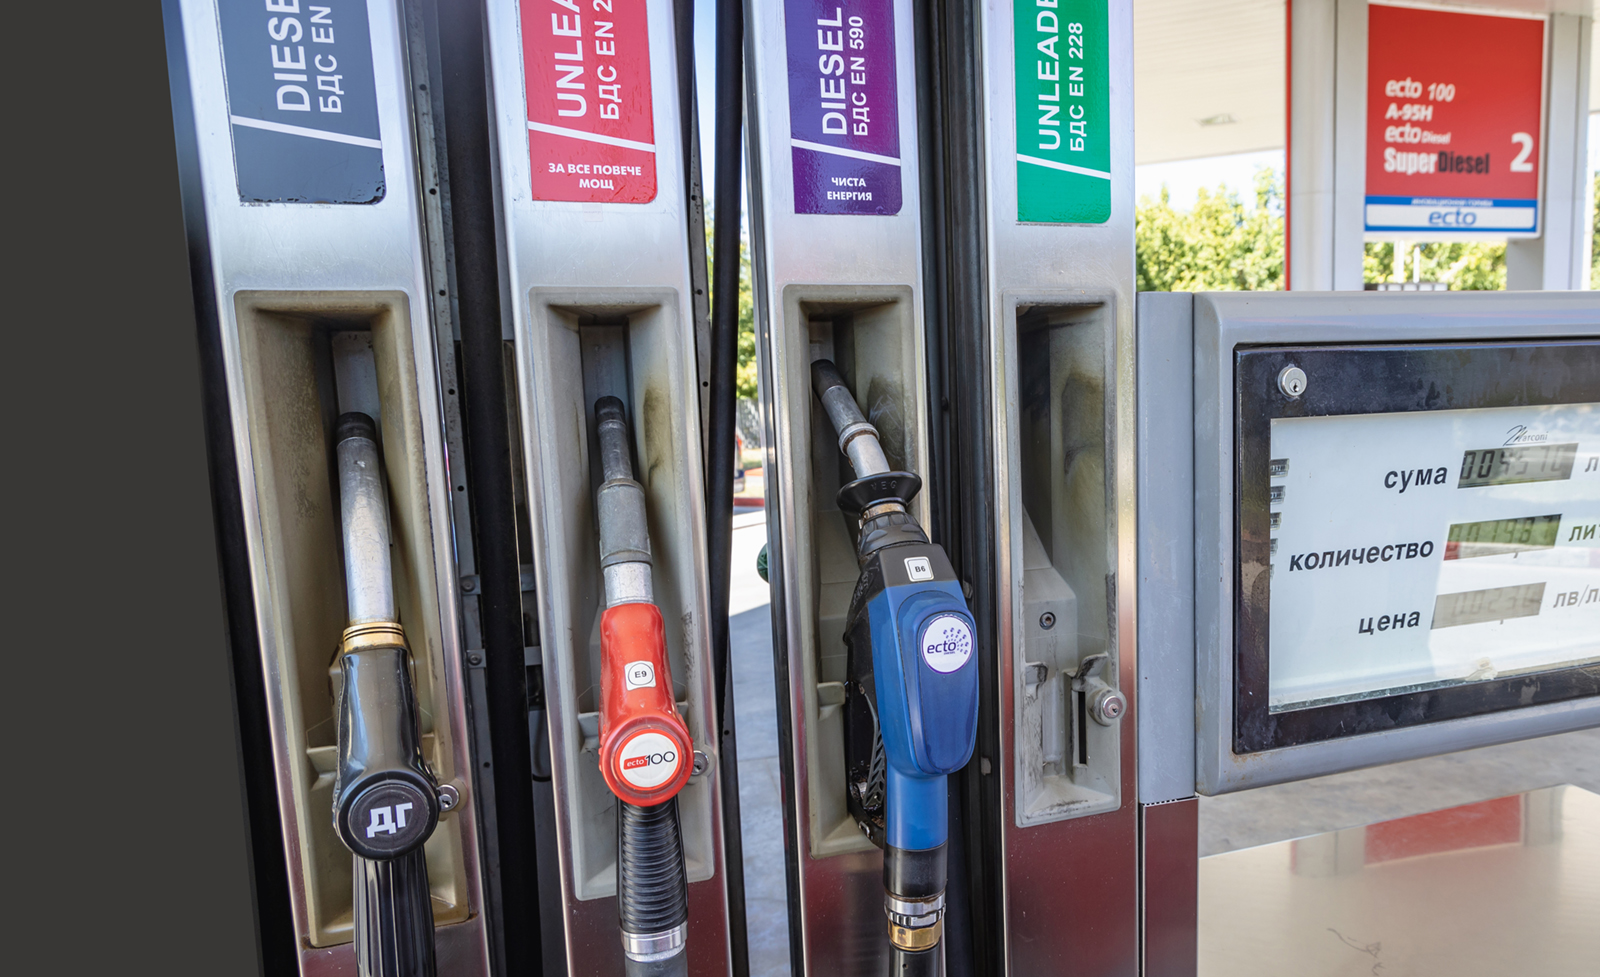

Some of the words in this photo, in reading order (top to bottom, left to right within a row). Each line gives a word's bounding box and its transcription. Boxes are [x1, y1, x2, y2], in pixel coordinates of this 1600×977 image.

[309, 5, 335, 44] EN
[594, 21, 615, 56] EN
[848, 16, 864, 50] 590
[1068, 22, 1083, 59] 228
[314, 54, 345, 113] БДС
[817, 7, 848, 135] DIESEL
[850, 57, 866, 85] EN
[1069, 66, 1084, 96] EN
[597, 65, 622, 120] БДС
[1385, 77, 1422, 98] ecto
[1428, 82, 1455, 102] 100
[851, 92, 870, 136] БДС
[1069, 104, 1087, 152] БДС
[1510, 132, 1534, 172] 2
[548, 163, 565, 174] ЗА
[568, 164, 591, 174] ВСЕ
[593, 165, 642, 176] ПОВЕЧЕ
[579, 179, 614, 190] МОЩ
[831, 177, 867, 187] ЧИСТА
[827, 191, 873, 201] ЕНЕРГИЯ
[1428, 208, 1477, 226] ecto
[1384, 467, 1448, 494] сума
[914, 565, 926, 573] B6
[1289, 540, 1434, 572] количество
[1358, 610, 1421, 636] цена
[1553, 584, 1600, 608] лв/л
[927, 640, 957, 654] ecto
[634, 670, 647, 679] E9
[366, 802, 413, 838] ДГ
